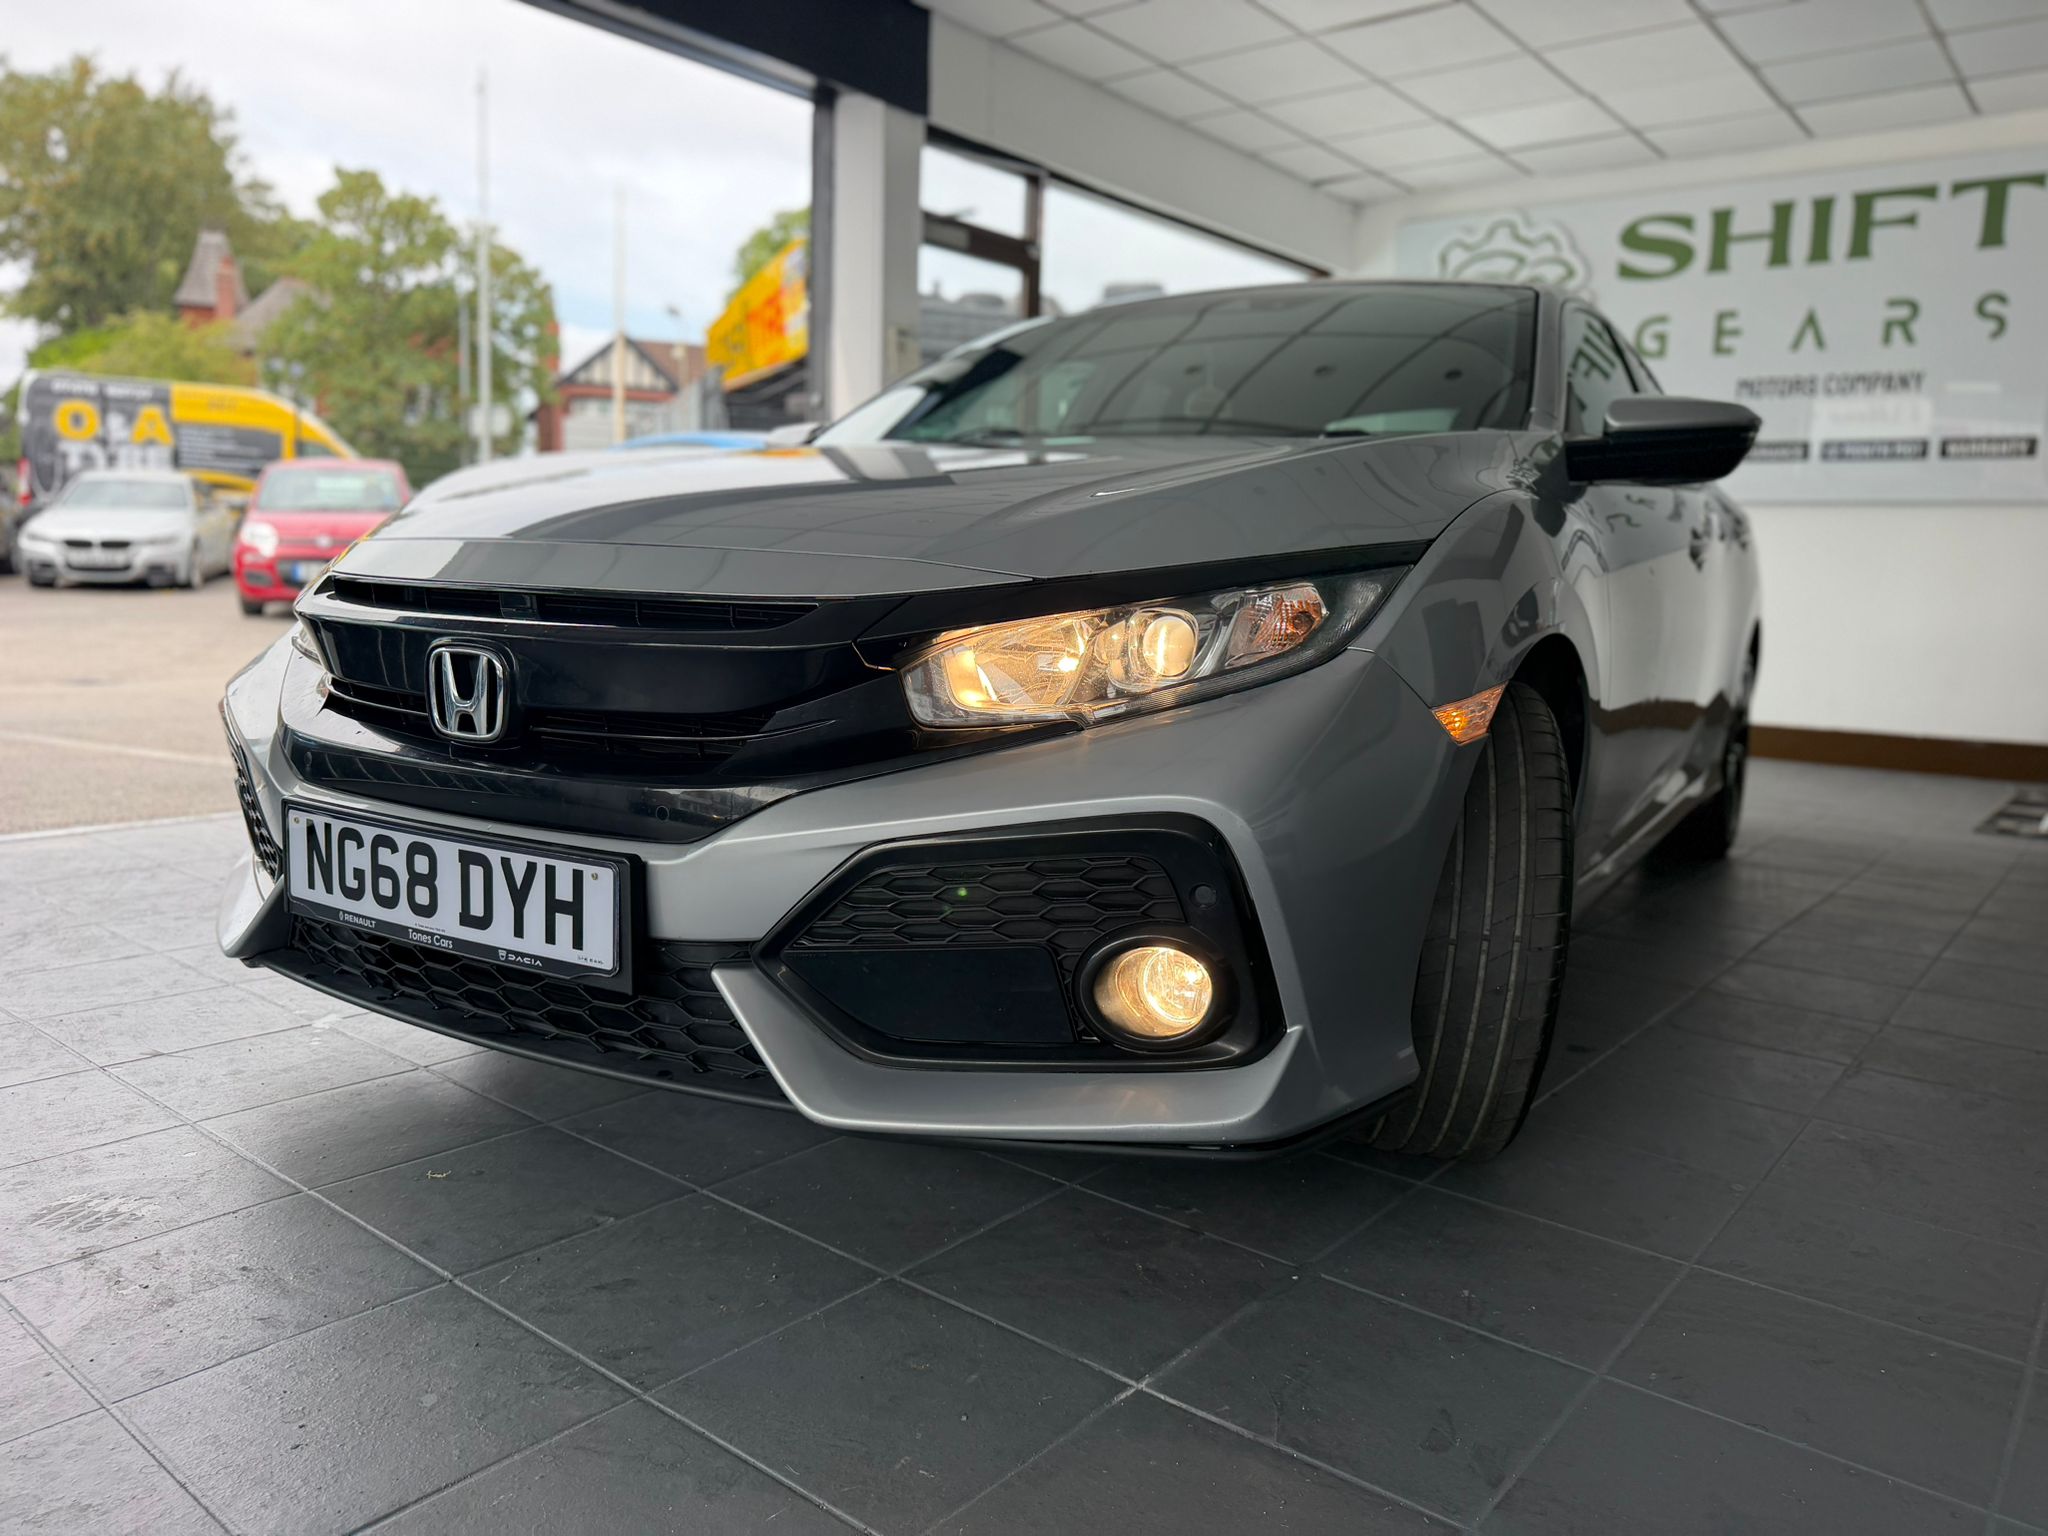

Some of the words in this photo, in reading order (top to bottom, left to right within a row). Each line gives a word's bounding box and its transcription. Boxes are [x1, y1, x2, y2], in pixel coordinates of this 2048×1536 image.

[1616, 173, 2047, 280] SHIFT
[1634, 293, 2010, 359] GEARS
[1823, 370, 1926, 396] COMPANY
[305, 818, 439, 919] NG68
[458, 848, 584, 951] DYH
[344, 913, 376, 928] RENAULT
[408, 929, 431, 944] Tones
[433, 935, 453, 949] Cars
[508, 953, 543, 967] DACIA
